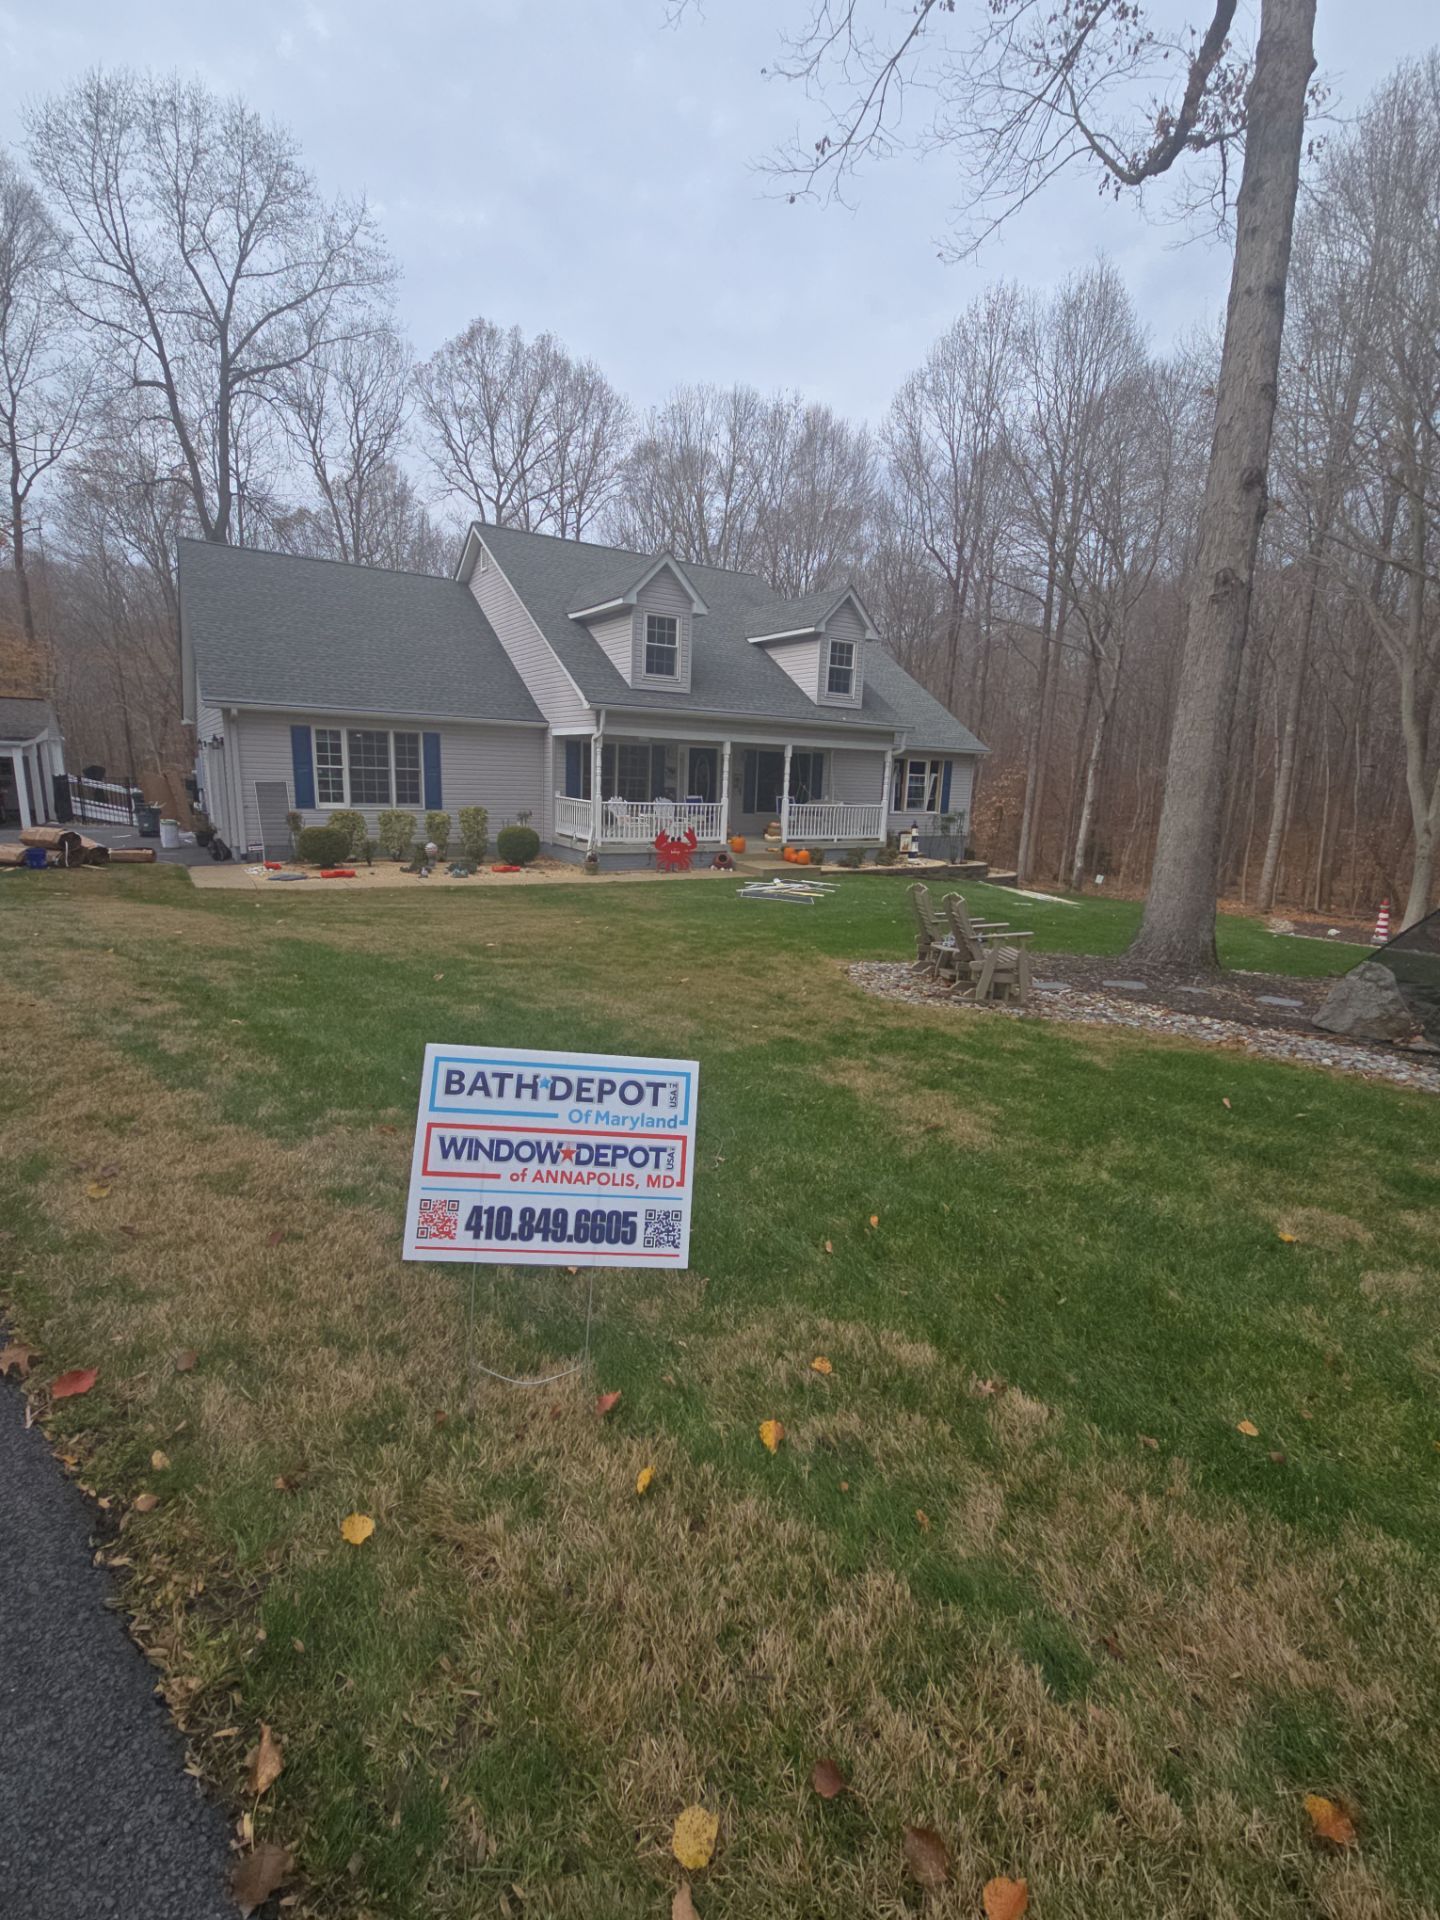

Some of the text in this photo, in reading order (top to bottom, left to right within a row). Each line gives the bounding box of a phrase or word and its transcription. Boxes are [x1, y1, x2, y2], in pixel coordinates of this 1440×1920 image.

[444, 1069, 666, 1107] BATH DEPOT
[669, 1089, 678, 1108] USA
[568, 1109, 678, 1131] Of Maryland
[438, 1136, 668, 1170] WINDOW DEPOT
[666, 1150, 675, 1170] USA
[509, 1168, 675, 1189] of ANNAPOLIS, MD
[464, 1205, 638, 1245] 410.849.6605
